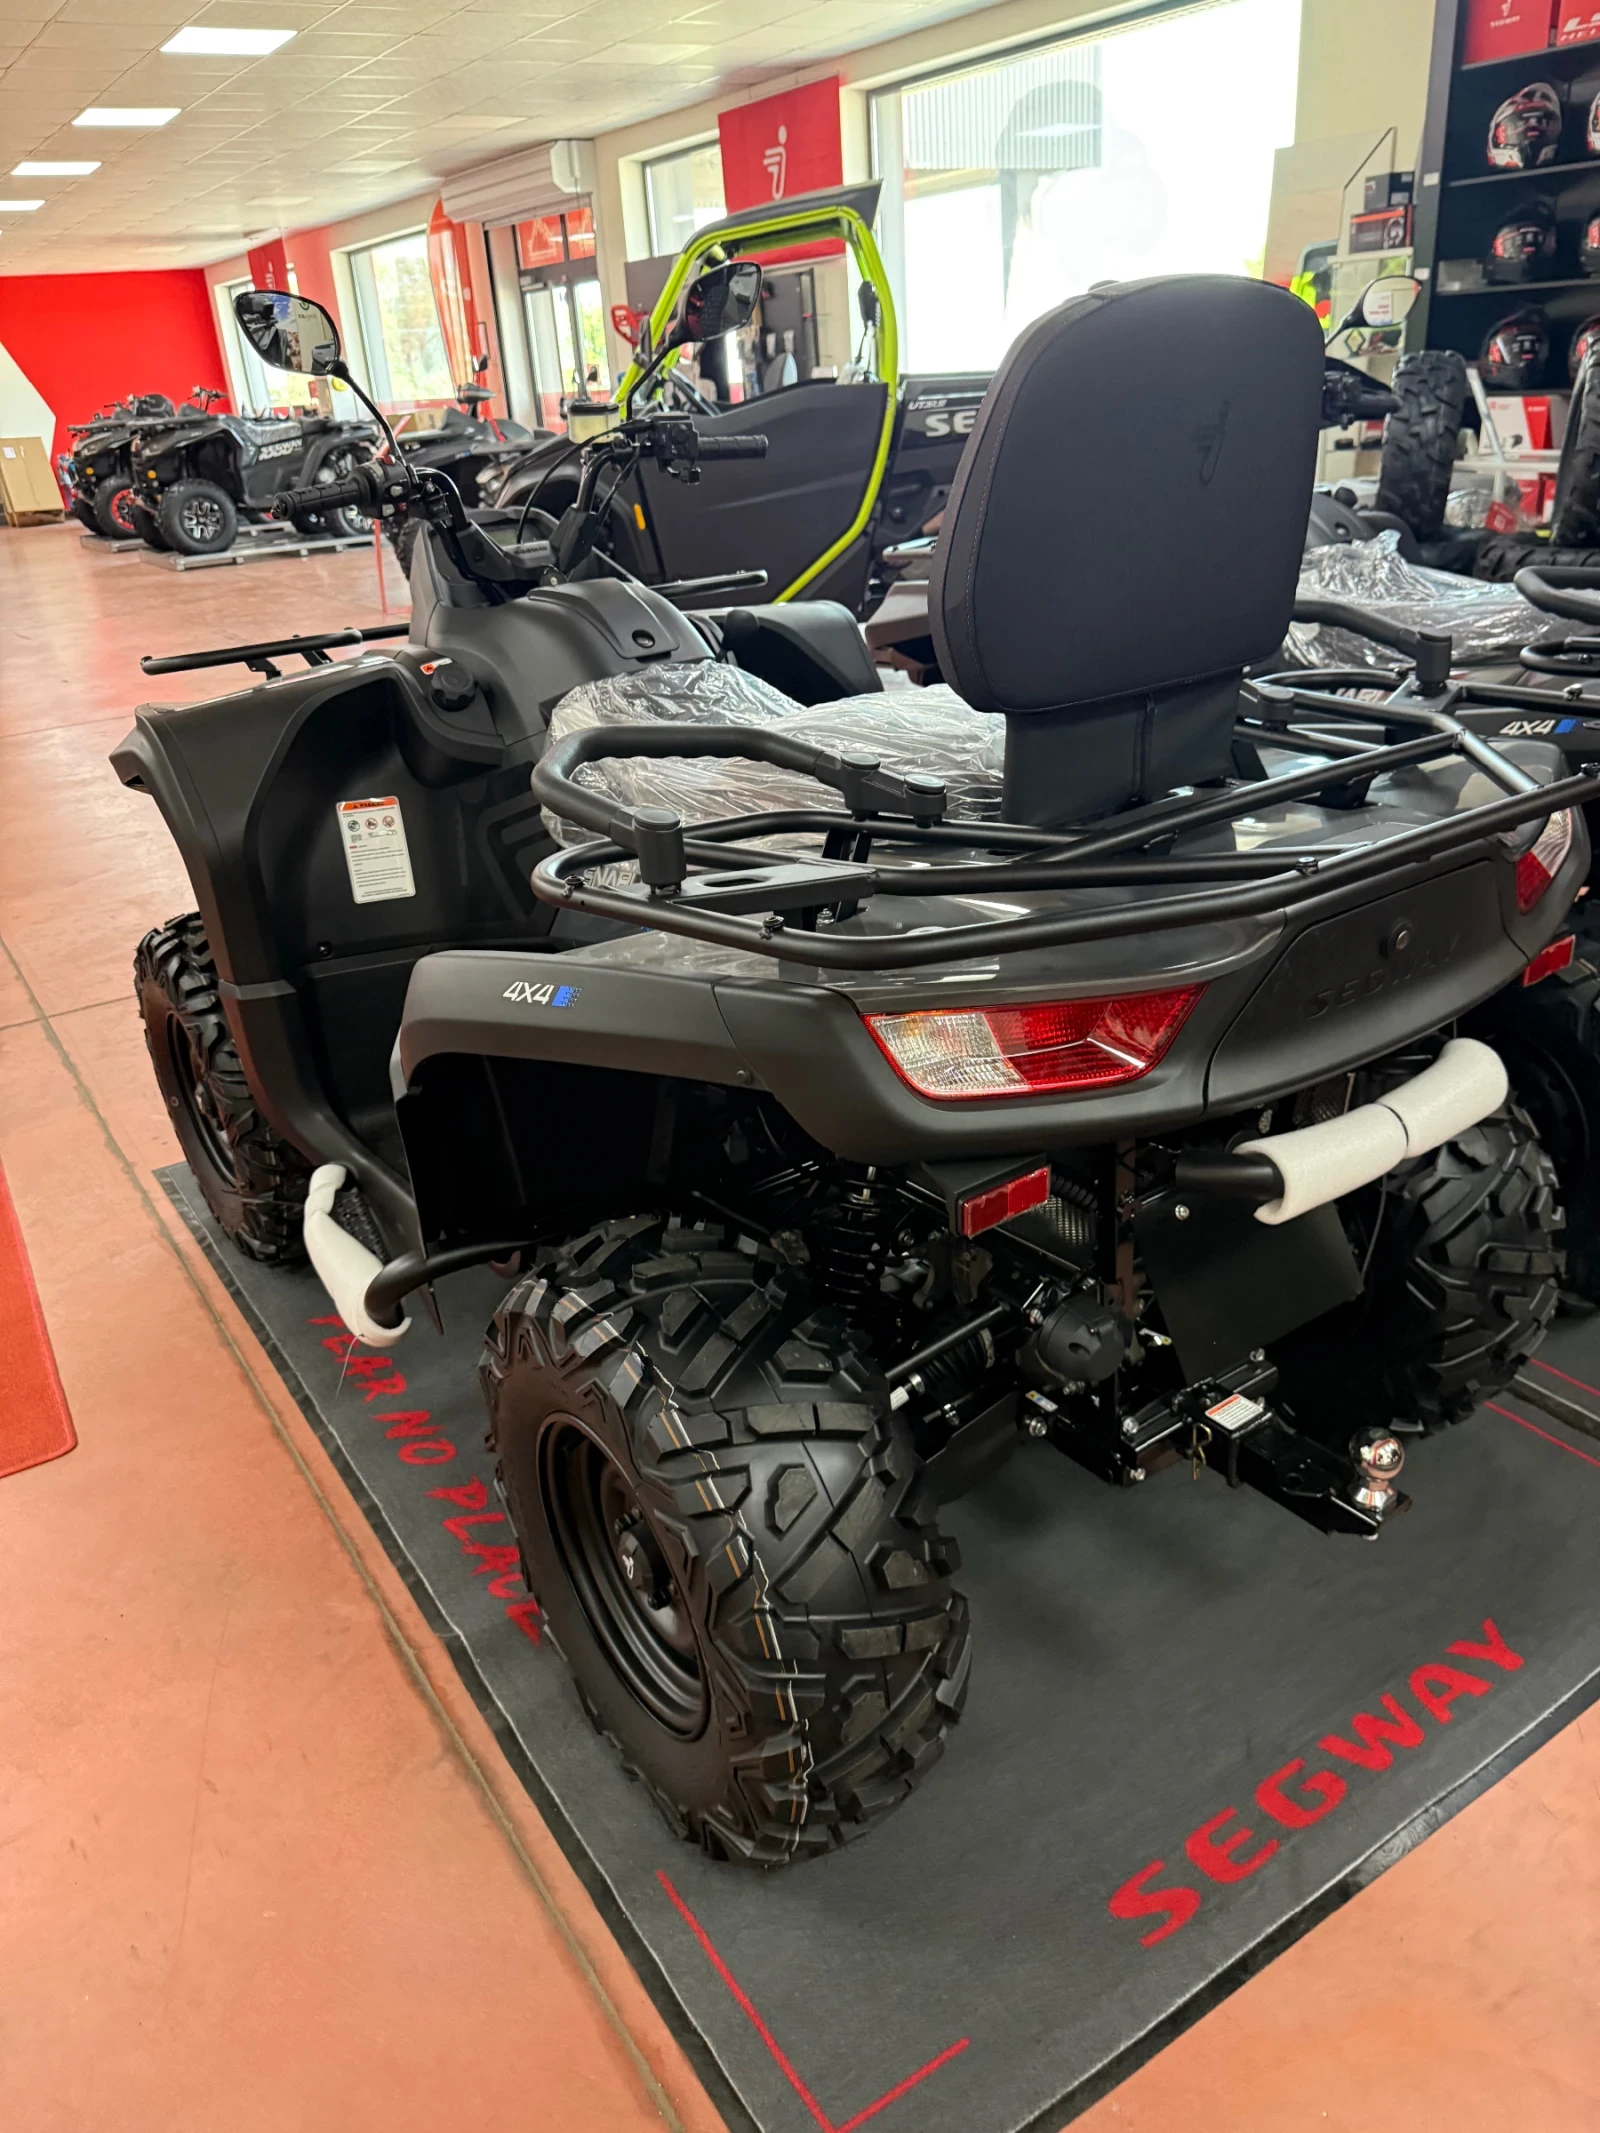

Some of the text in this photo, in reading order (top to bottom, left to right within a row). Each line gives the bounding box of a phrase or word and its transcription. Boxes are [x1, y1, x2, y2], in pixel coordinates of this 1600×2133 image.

[925, 409, 977, 437] SE
[502, 981, 555, 1005] 4X4
[371, 1409, 457, 1466] NO
[1109, 1618, 1525, 1947] SEGWAY
